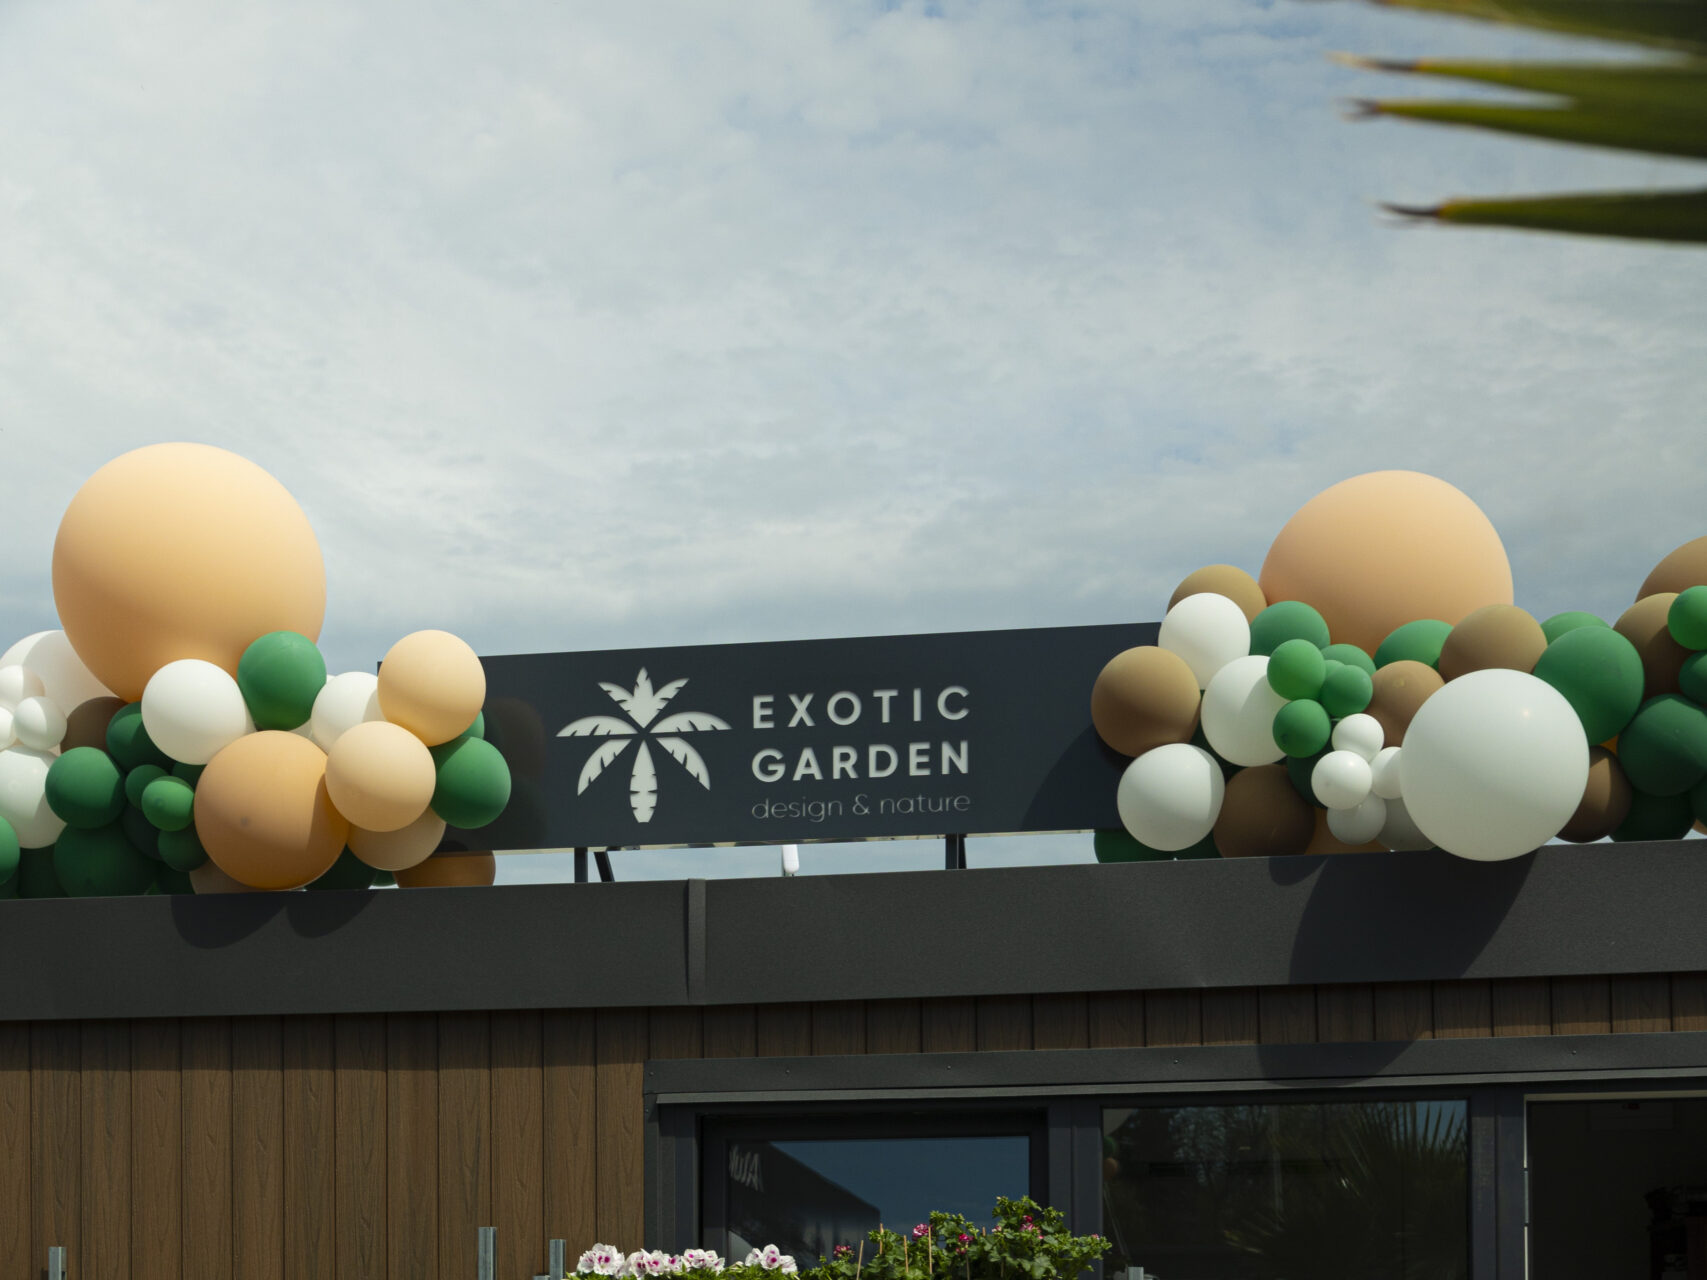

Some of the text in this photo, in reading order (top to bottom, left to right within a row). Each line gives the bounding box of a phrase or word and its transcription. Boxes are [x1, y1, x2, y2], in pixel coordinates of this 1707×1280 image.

[753, 686, 970, 729] EXOTIC
[752, 741, 969, 783] GARDEN
[752, 794, 971, 823] design & nature
